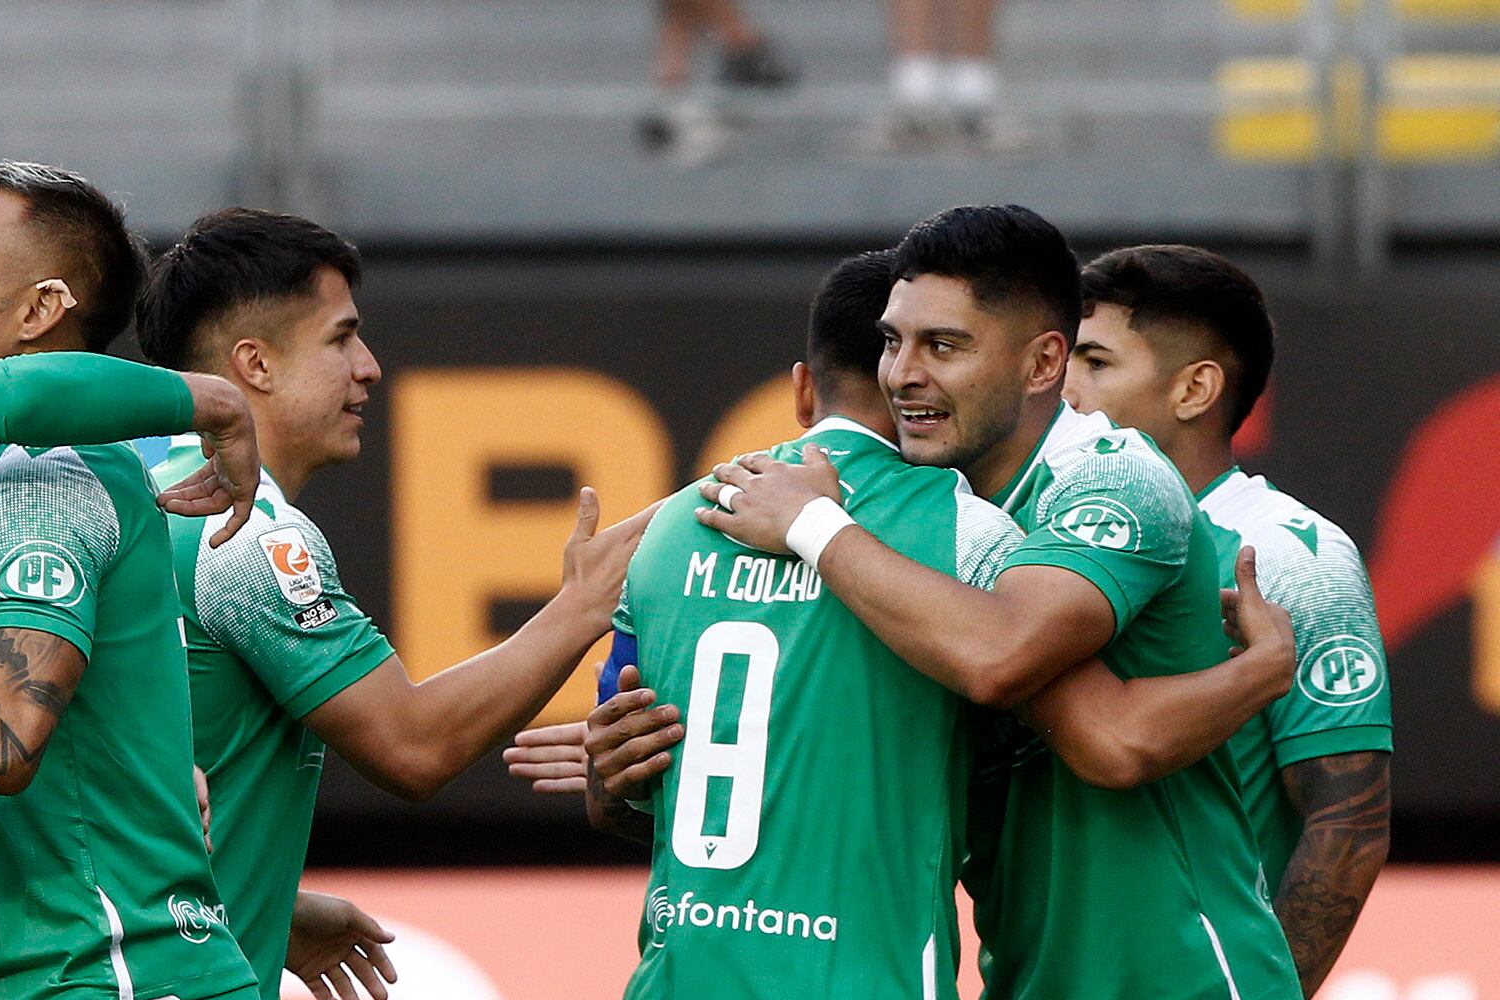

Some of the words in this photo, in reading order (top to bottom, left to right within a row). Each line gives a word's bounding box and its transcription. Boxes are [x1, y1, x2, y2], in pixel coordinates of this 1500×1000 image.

[17, 558, 66, 596] PF
[302, 608, 317, 621] NO
[671, 620, 780, 869] 8
